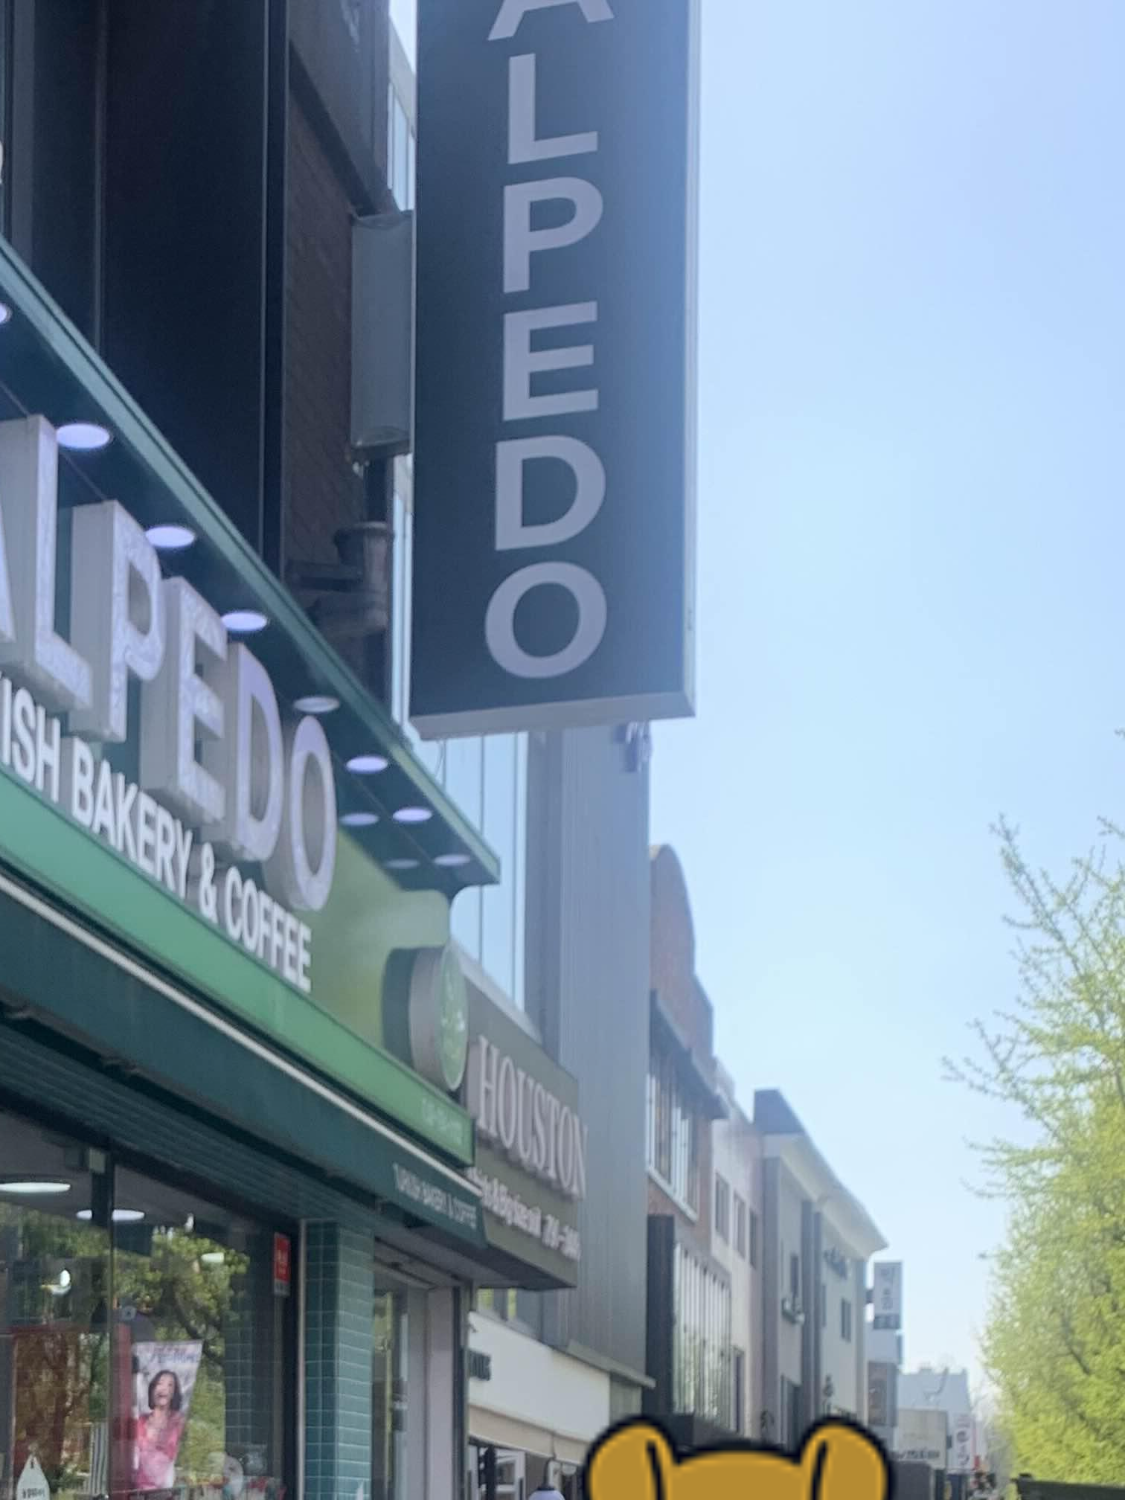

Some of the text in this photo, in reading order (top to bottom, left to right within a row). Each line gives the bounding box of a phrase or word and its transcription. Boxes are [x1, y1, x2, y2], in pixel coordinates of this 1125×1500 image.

[70, 736, 193, 900] BAKERY
[197, 842, 219, 925] &
[223, 866, 312, 993] COFFEE
[475, 1034, 588, 1201] HOUSTON
